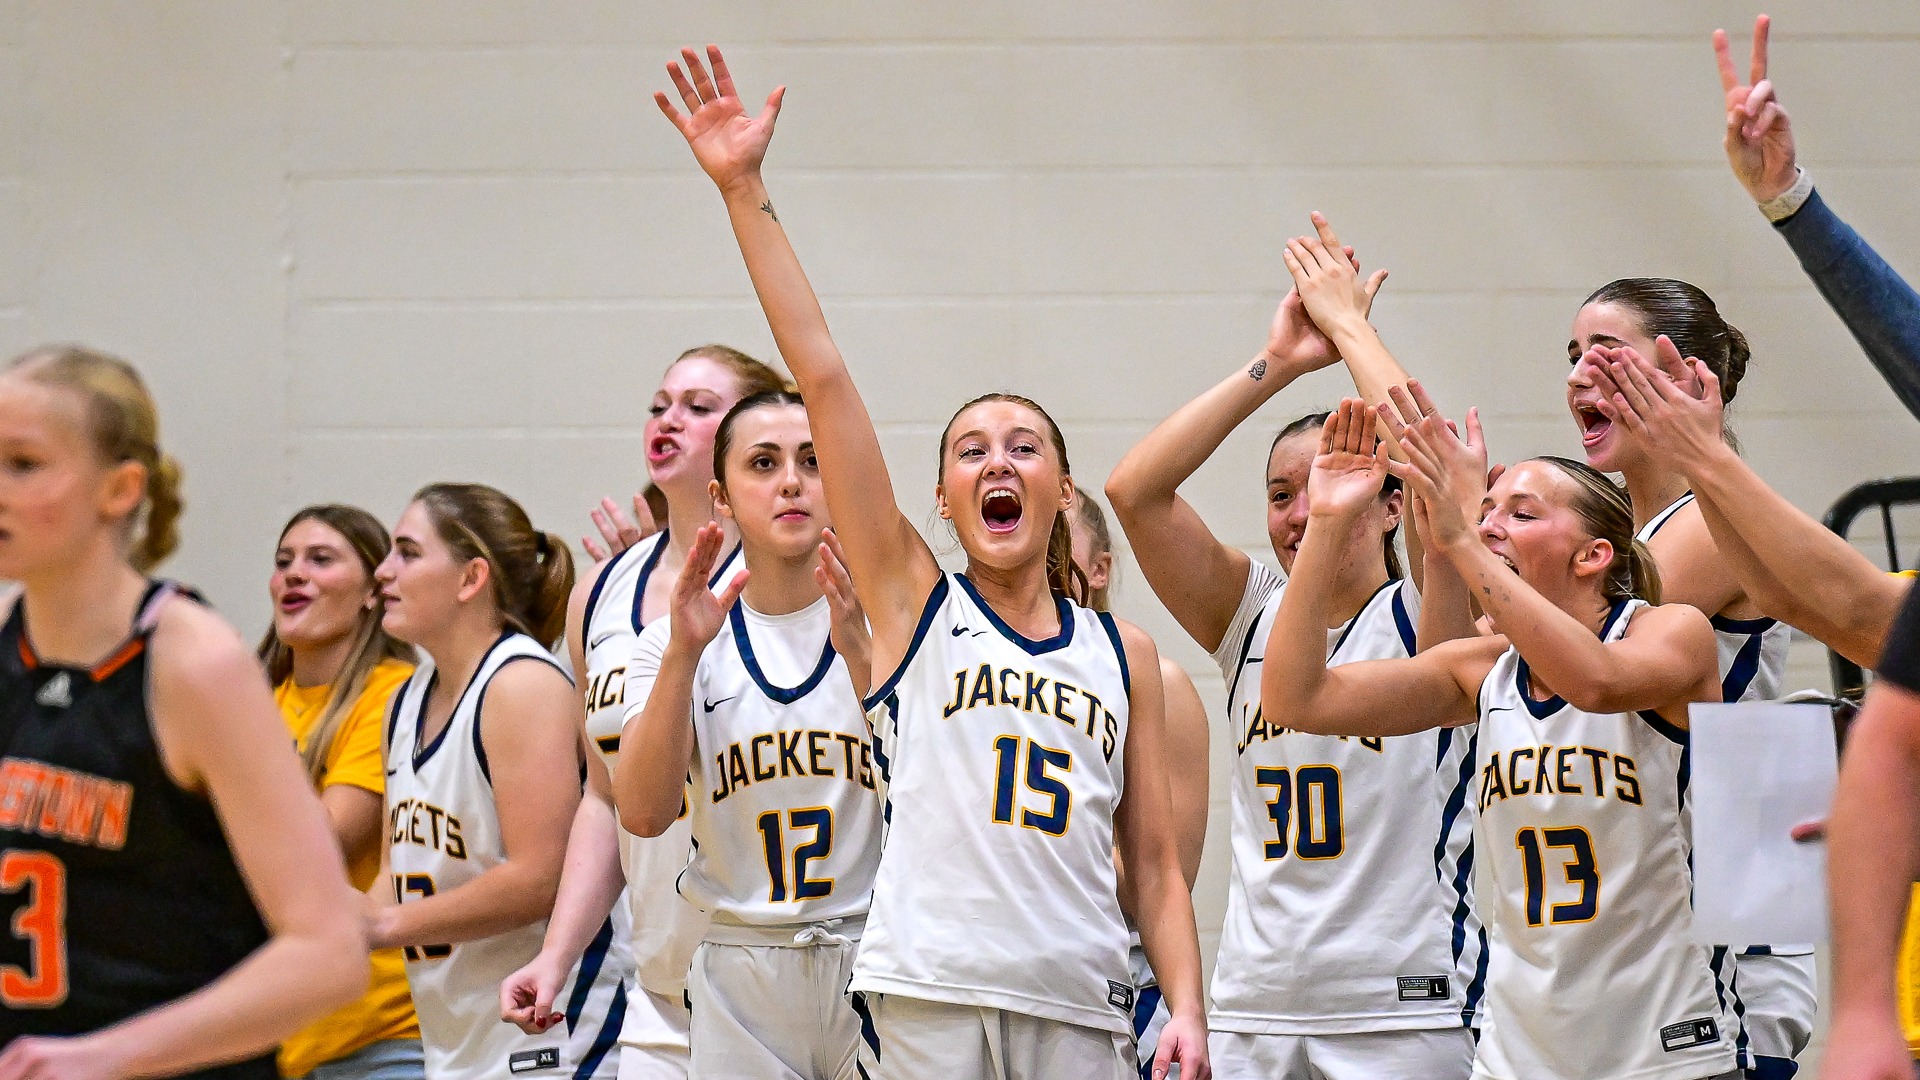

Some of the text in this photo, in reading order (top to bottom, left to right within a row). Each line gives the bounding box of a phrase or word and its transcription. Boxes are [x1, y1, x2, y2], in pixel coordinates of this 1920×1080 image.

[943, 663, 1118, 764] JACKETS
[712, 729, 878, 804] JACKETS
[991, 734, 1073, 837] 15
[1255, 764, 1346, 862] 30
[1478, 744, 1644, 817] JACKETS
[756, 805, 835, 903] 12
[1514, 825, 1603, 928] 13
[0, 849, 69, 1010] 3
[540, 1051, 555, 1064] XL
[1699, 1025, 1712, 1037] M
